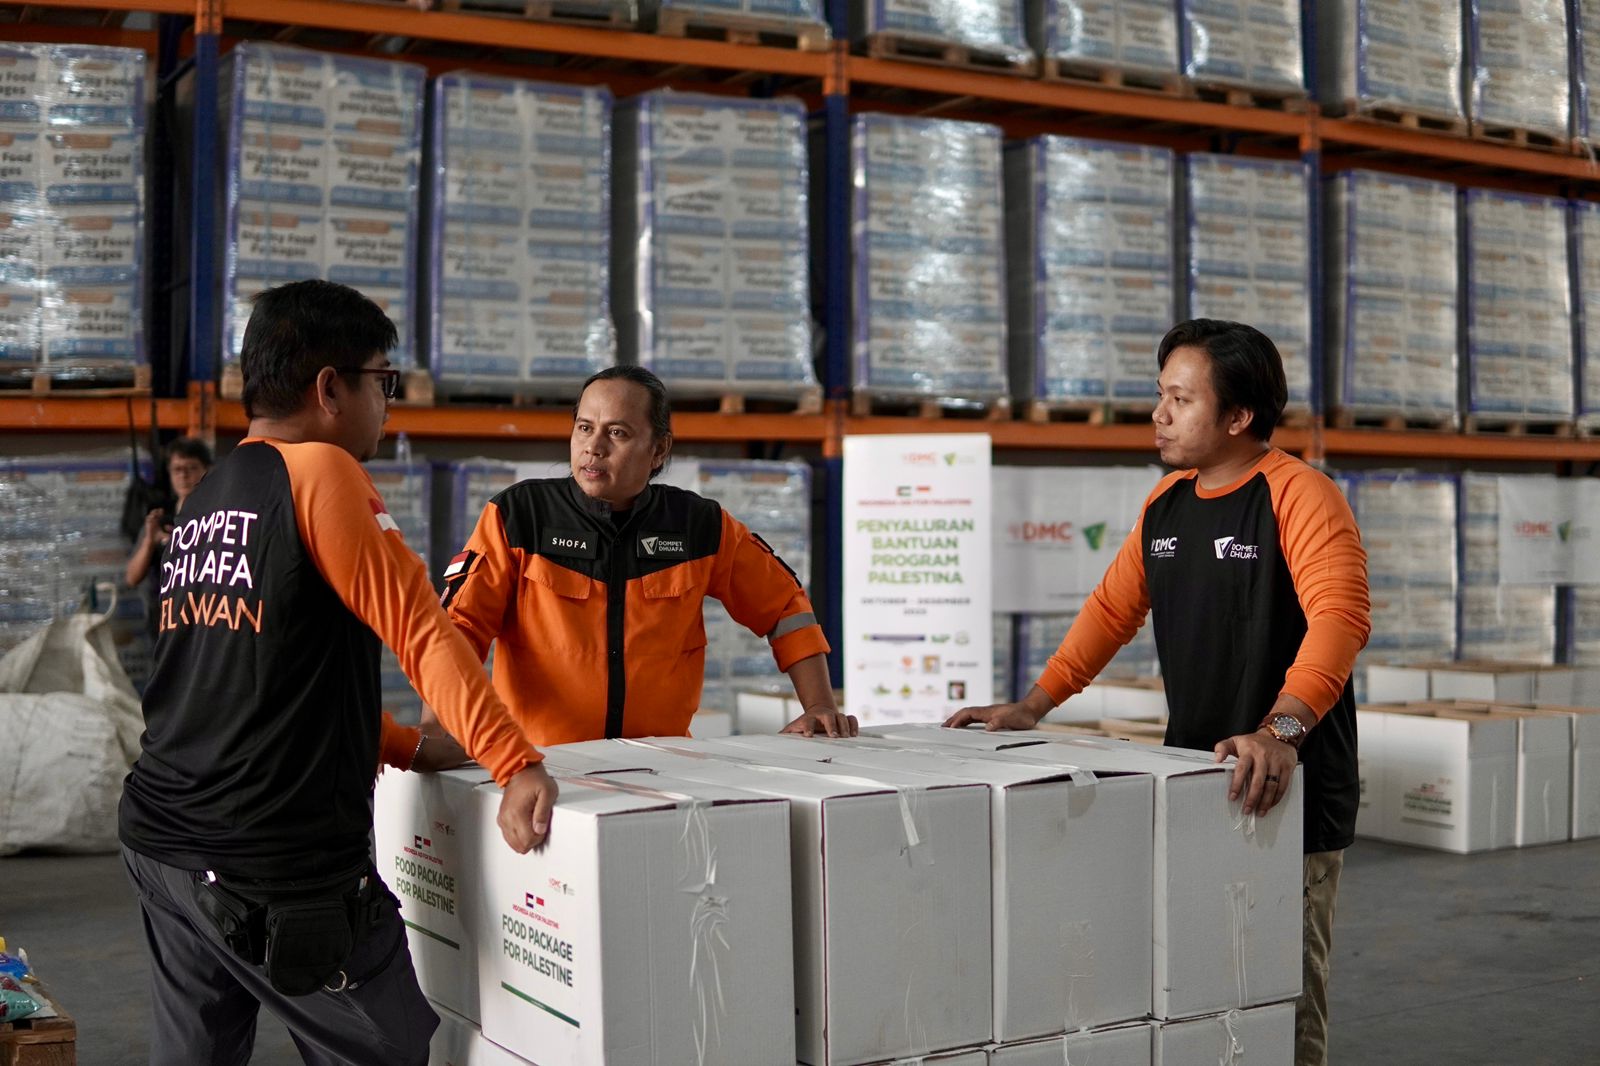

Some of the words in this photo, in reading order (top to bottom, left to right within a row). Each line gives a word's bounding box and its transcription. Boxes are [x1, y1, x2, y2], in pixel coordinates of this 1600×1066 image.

[857, 518, 974, 533] PENYALURAN
[552, 537, 587, 550] SHOFA
[872, 536, 959, 550] BANTUAN
[871, 553, 960, 567] PROGRAM
[867, 571, 965, 584] PALESTINA
[395, 855, 416, 877] FOOD
[418, 865, 455, 893] PACKAGE
[396, 877, 411, 897] FOR
[413, 883, 455, 915] PALESTINE
[502, 913, 526, 940] FOOD
[528, 926, 573, 962] PACKAGE
[503, 938, 521, 962] FOR
[522, 947, 573, 988] PALESTINE
